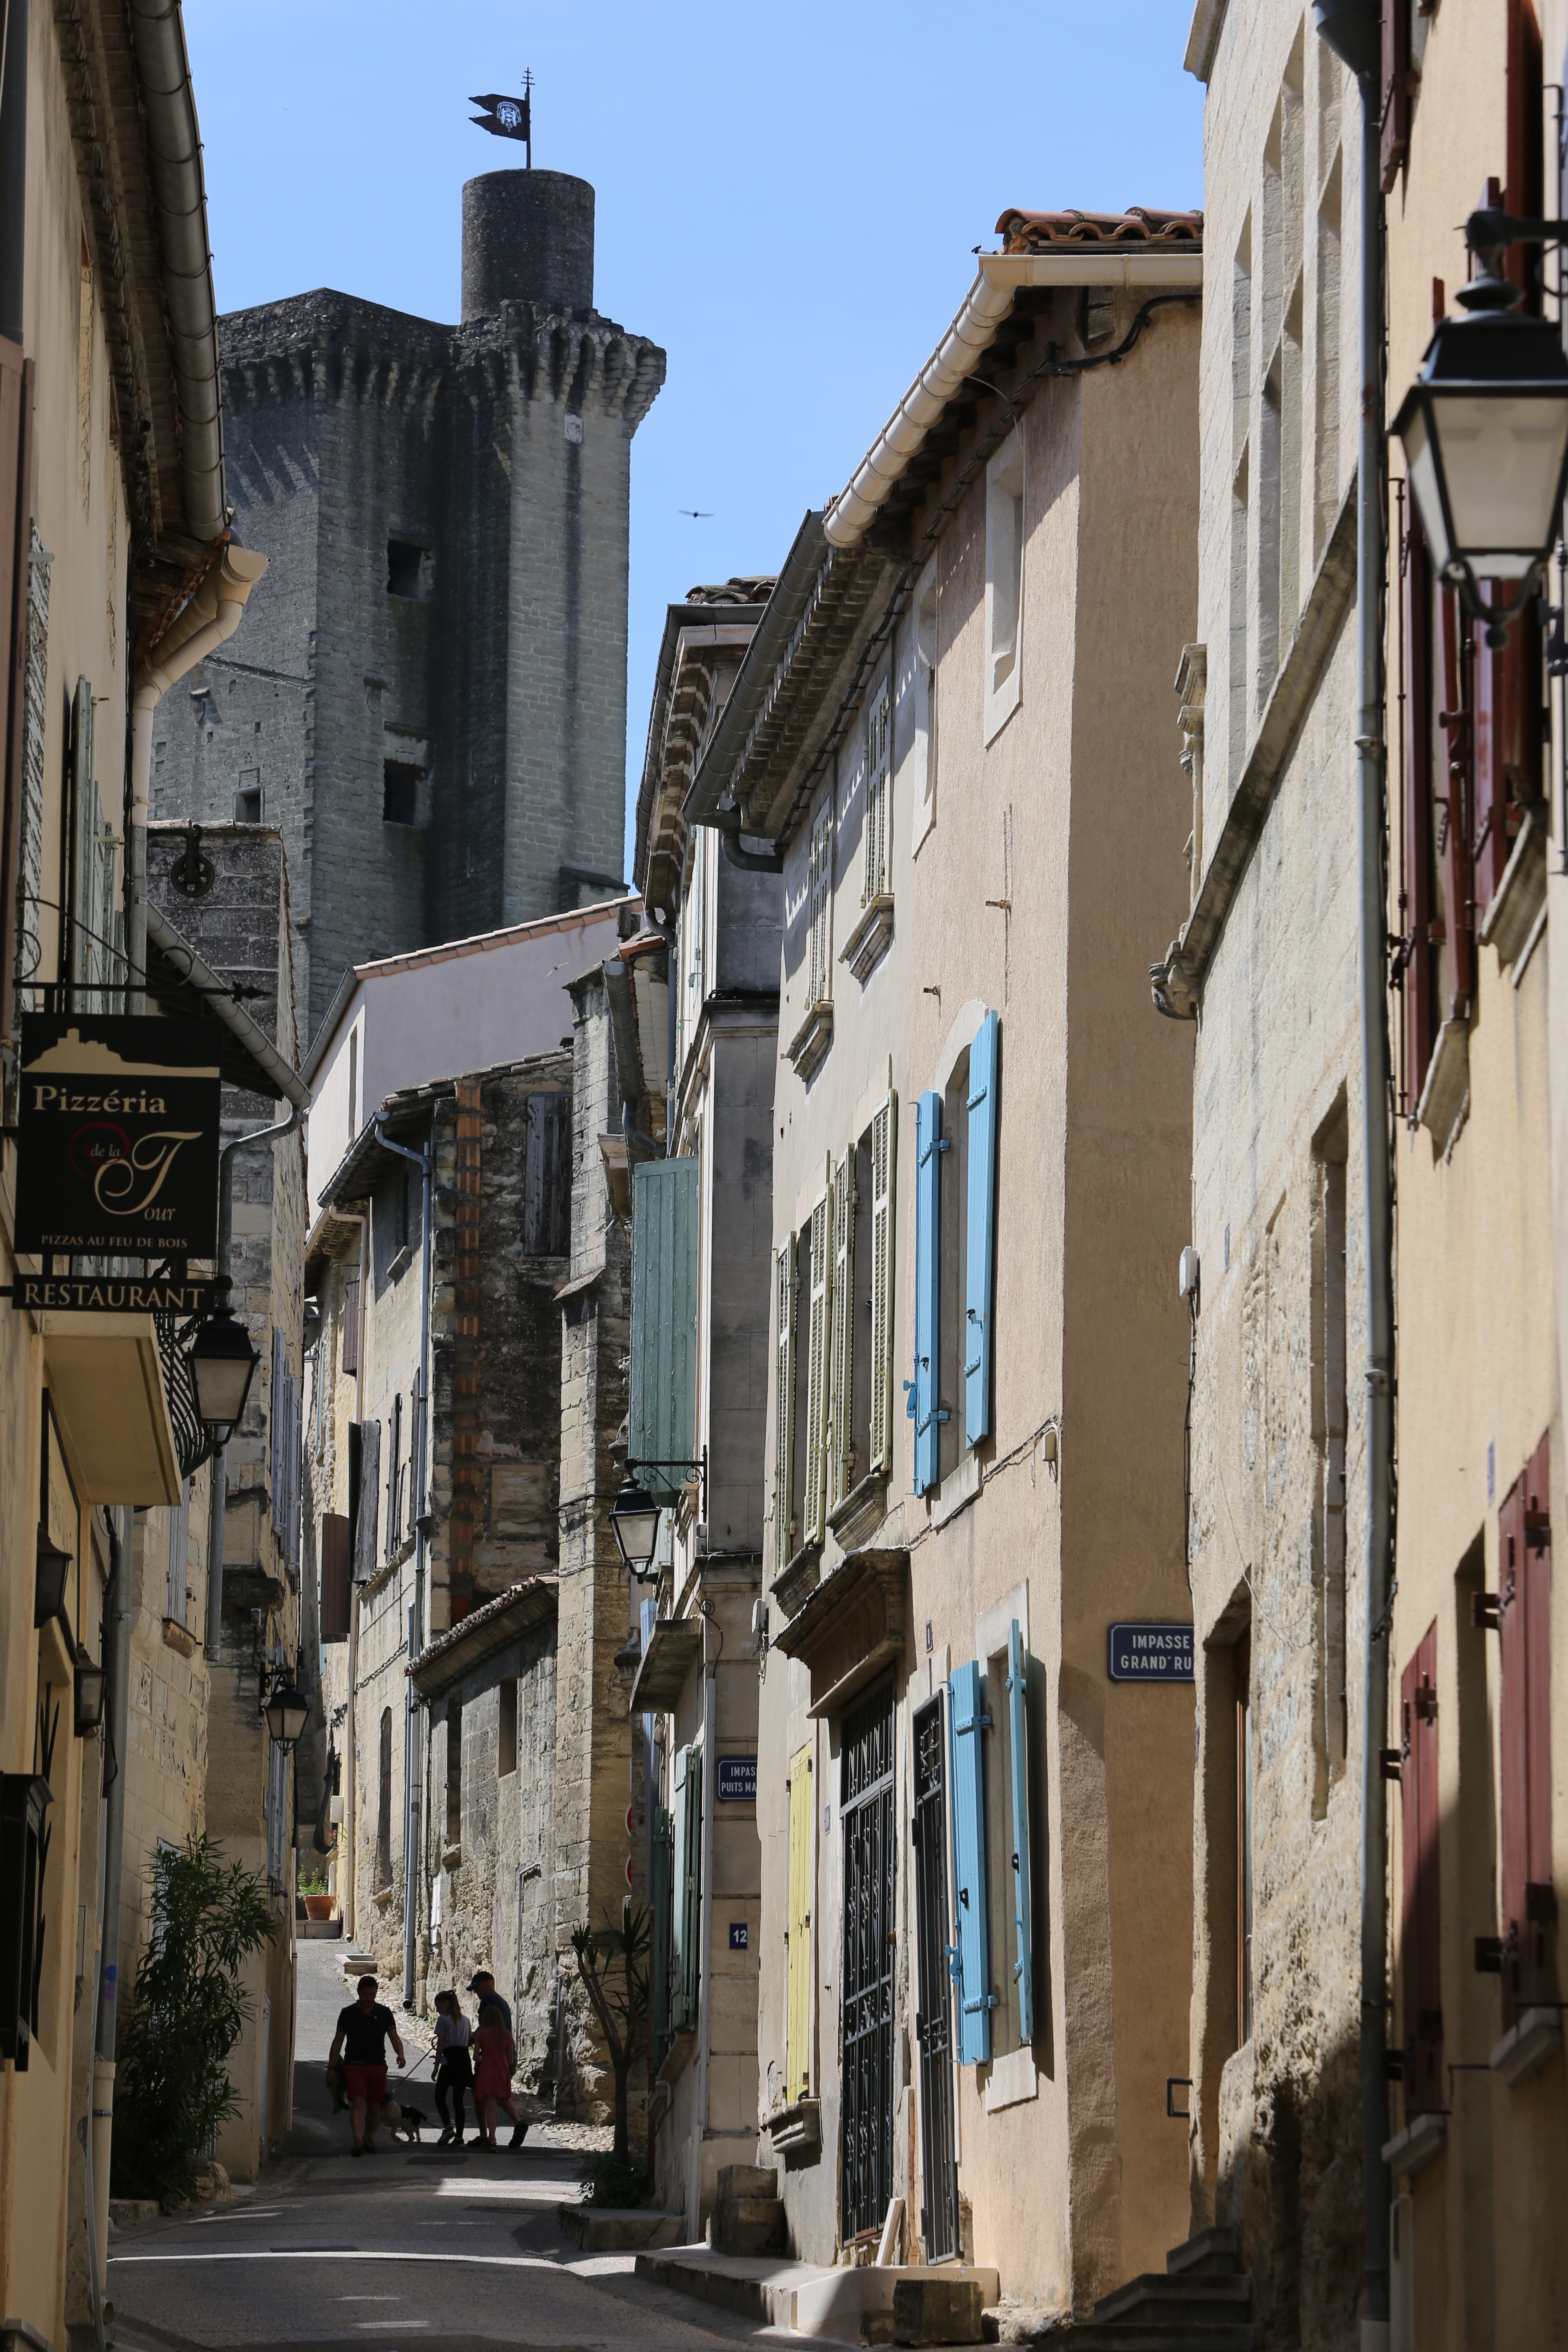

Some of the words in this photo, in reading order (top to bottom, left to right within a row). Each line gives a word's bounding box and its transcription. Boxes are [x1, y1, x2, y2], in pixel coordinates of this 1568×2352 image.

[33, 1085, 167, 1114] Pizzéria
[91, 1143, 105, 1157] de
[109, 1144, 120, 1158] la
[94, 1131, 203, 1221] Tour
[41, 1235, 84, 1245] PIZZAS
[87, 1236, 105, 1246] AU
[109, 1237, 132, 1247] FEU
[137, 1238, 154, 1247] DE
[158, 1238, 188, 1248] BOIS
[24, 1283, 205, 1309] RESTAURANT
[1132, 1635, 1190, 1649] IMPASSE
[731, 1766, 757, 1777] IMPAS
[722, 1782, 743, 1792] PUITS
[733, 1930, 747, 1942] 12
